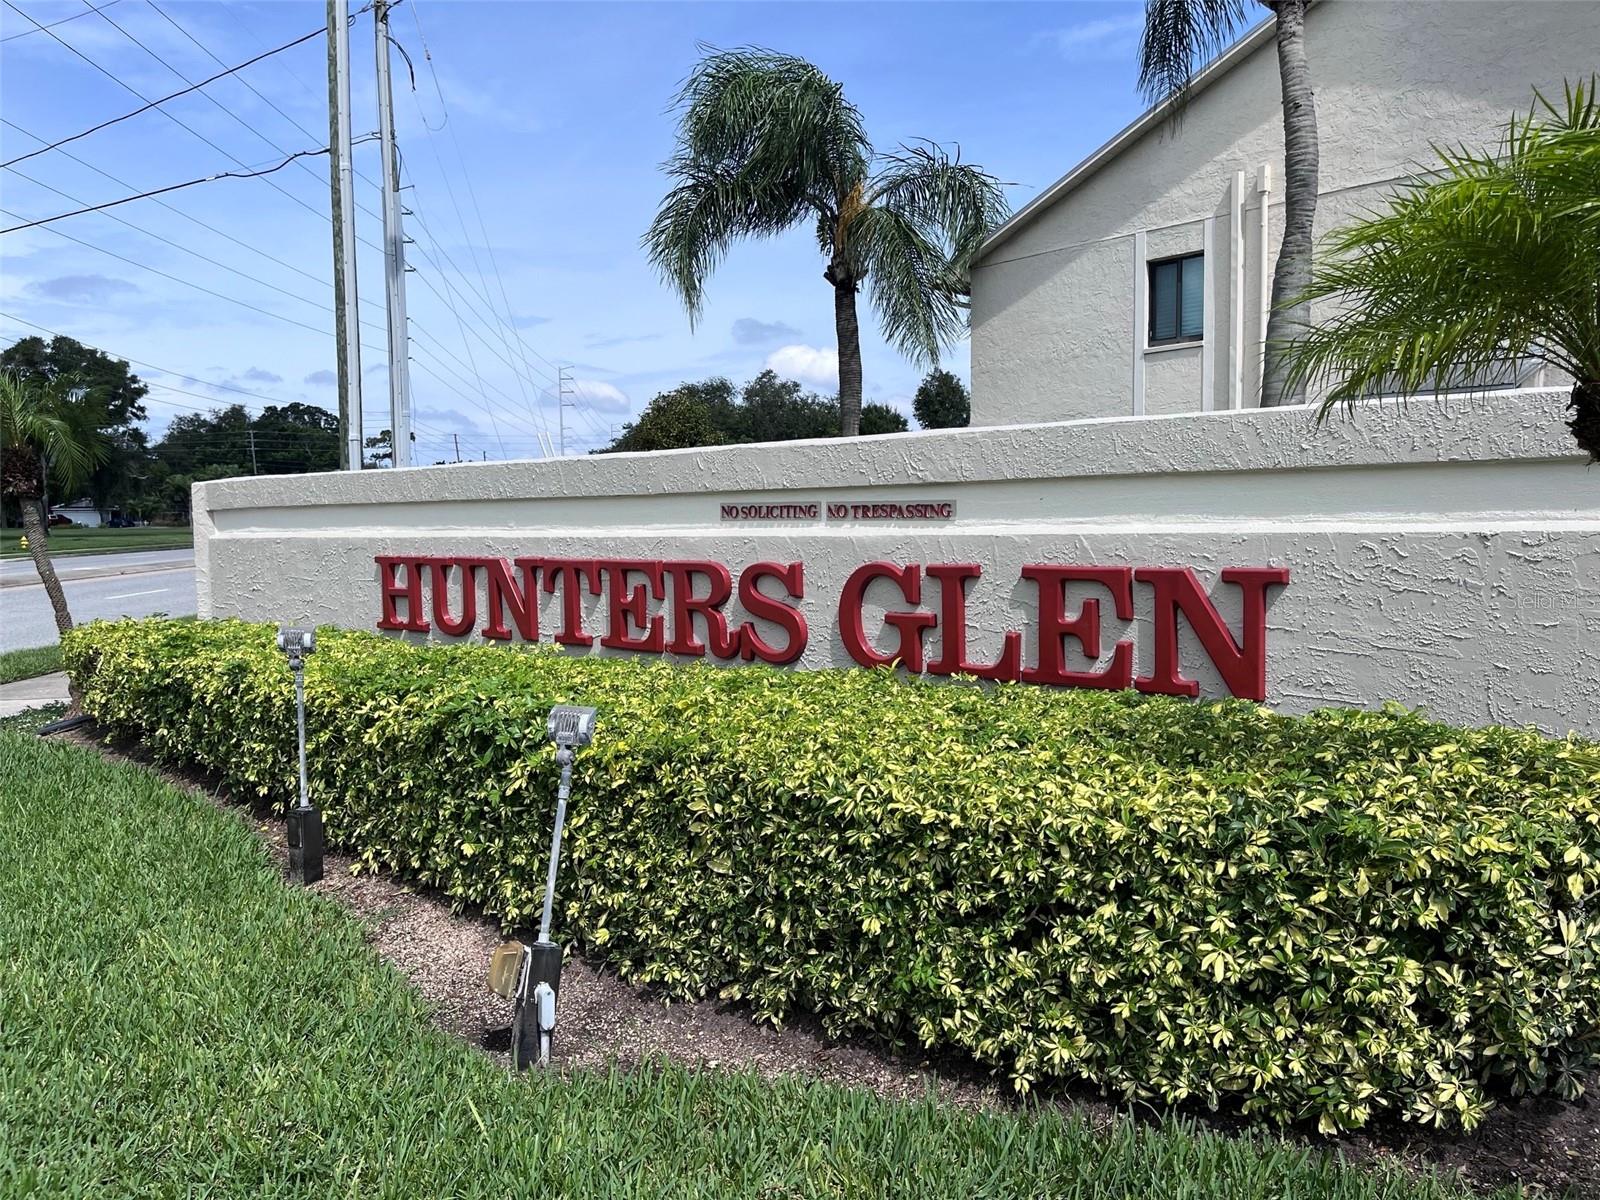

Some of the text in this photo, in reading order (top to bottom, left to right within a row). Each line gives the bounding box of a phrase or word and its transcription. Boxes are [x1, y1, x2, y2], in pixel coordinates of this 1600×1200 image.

[721, 504, 819, 519] NO SOLICITING
[827, 503, 953, 518] NO TRESPASSING
[374, 556, 1290, 702] HUNTERS GLEN
